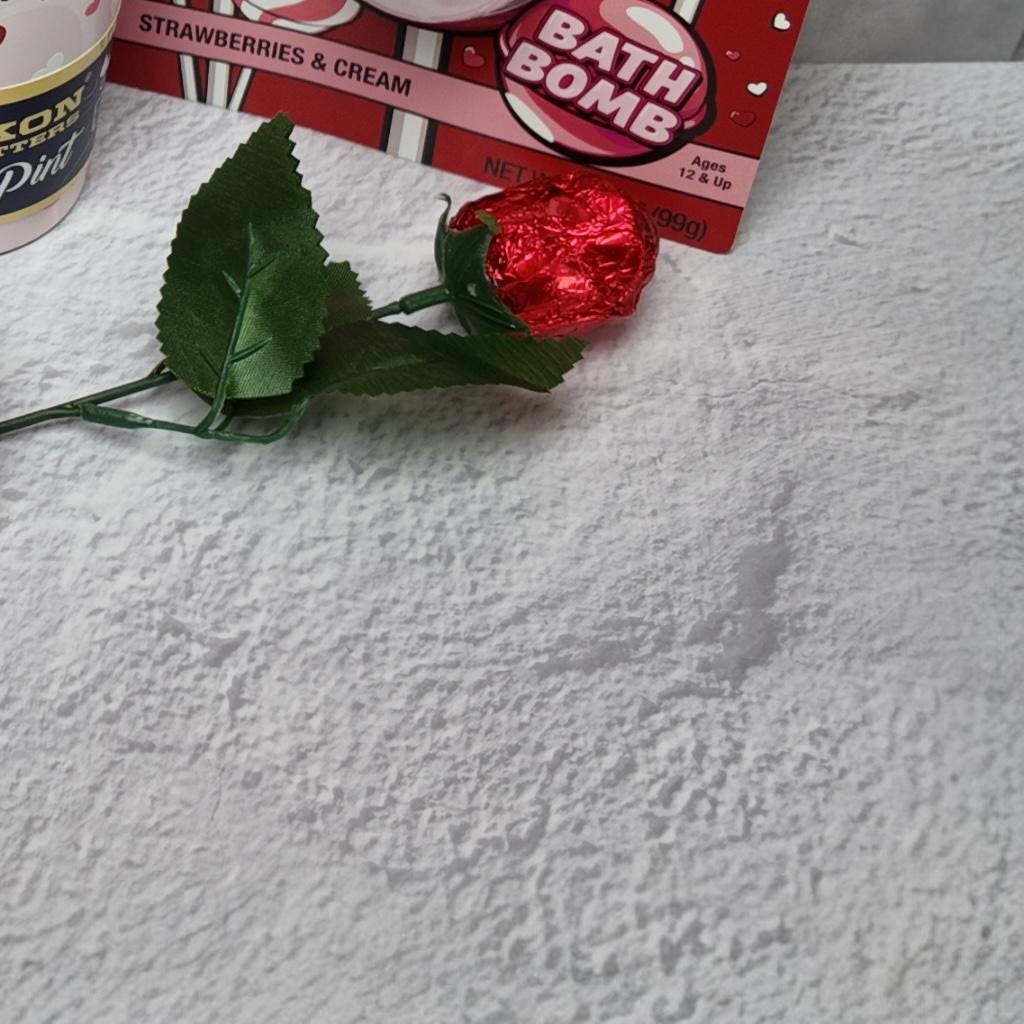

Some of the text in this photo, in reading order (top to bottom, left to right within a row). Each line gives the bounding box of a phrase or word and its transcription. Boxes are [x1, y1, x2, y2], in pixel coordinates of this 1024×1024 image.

[139, 13, 305, 67] STRAWBERRIES
[310, 52, 327, 72] &
[334, 58, 412, 97] CREAM
[537, 7, 702, 106] BATH
[504, 38, 682, 146] BOMB
[484, 156, 528, 183] NET
[679, 167, 732, 191] 12 & Up
[691, 155, 727, 174] Ages
